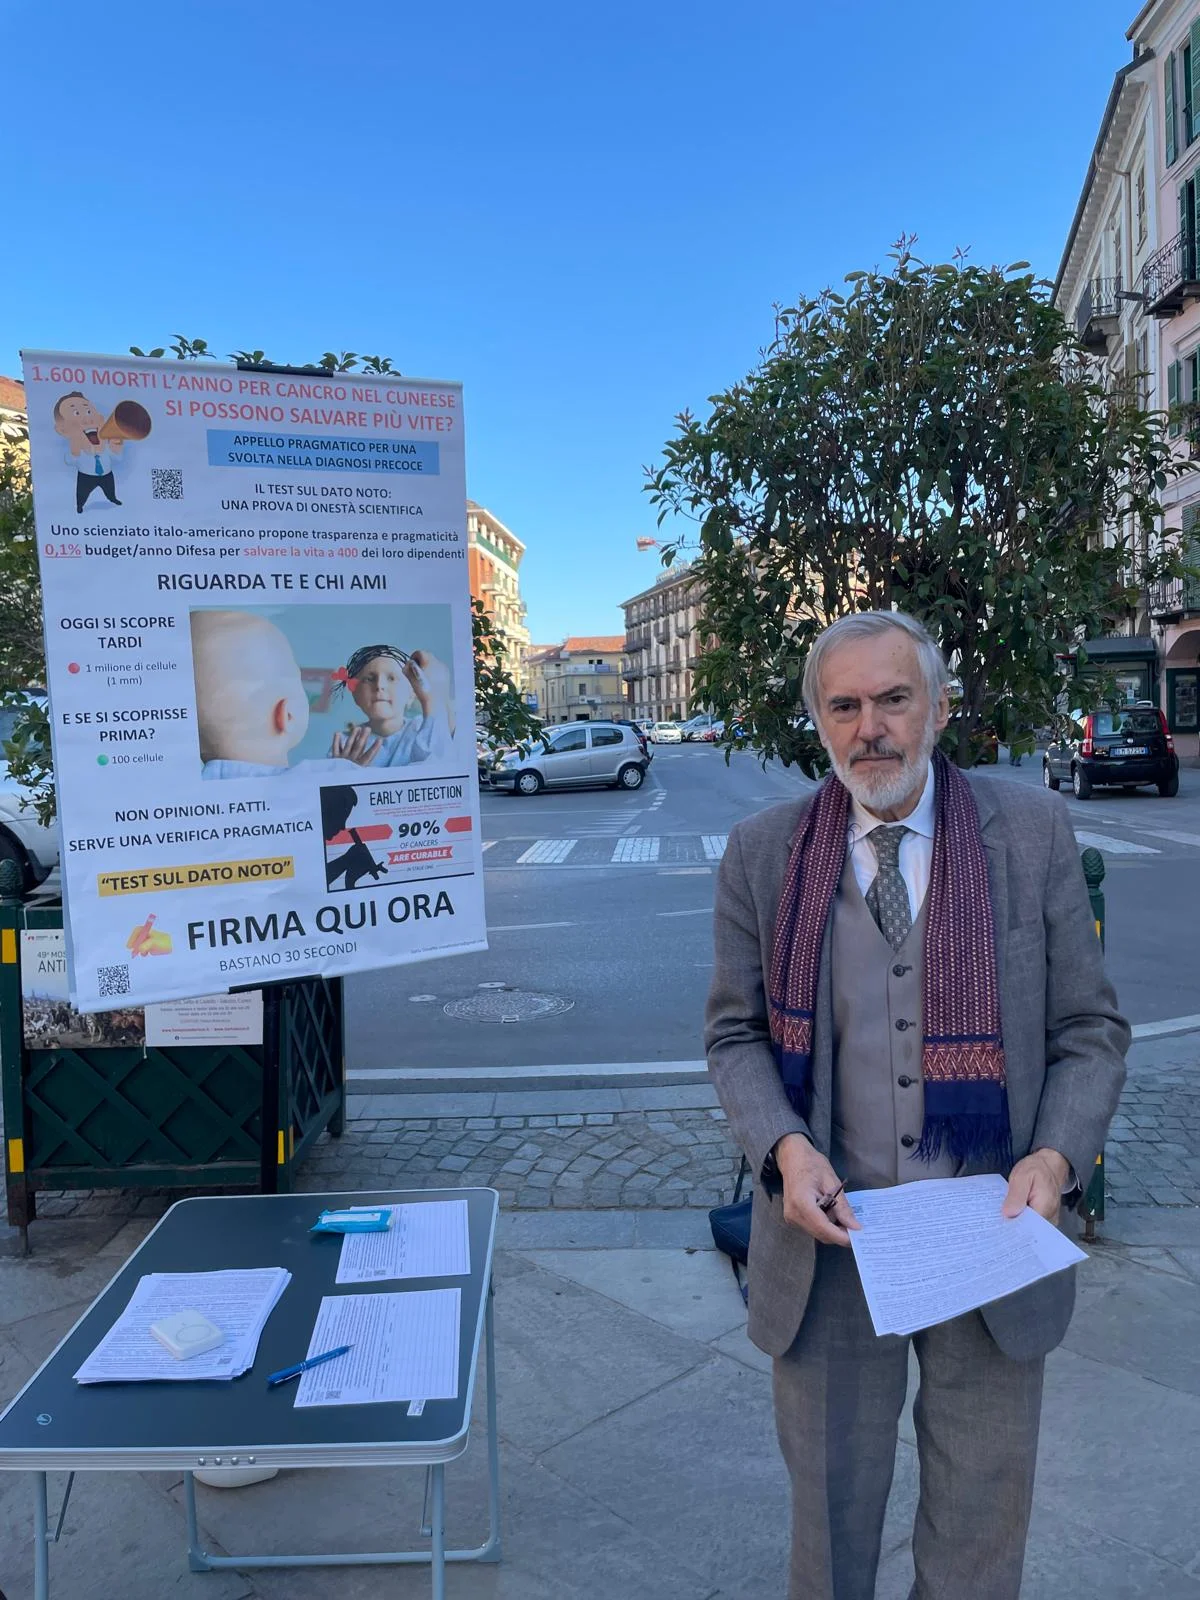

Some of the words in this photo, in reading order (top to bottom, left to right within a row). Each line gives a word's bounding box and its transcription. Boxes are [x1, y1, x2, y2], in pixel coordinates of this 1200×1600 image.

[32, 365, 85, 384] 1.600
[92, 369, 156, 388] MORTI
[239, 380, 271, 397] PER
[275, 382, 347, 401] CANCRO
[352, 388, 381, 404] NEL
[386, 390, 455, 408] CUNEESE
[166, 399, 184, 416] SI
[190, 401, 284, 422] POSSONO
[290, 407, 367, 427] SALVARE
[373, 408, 402, 429] PIÙ
[407, 414, 453, 432] VITE?
[234, 434, 284, 449] APPELLO
[288, 437, 365, 452] PRAGMATICO
[369, 441, 389, 453] PER
[392, 442, 416, 455] UNA
[228, 452, 274, 465] SVOLTA
[277, 454, 311, 467] NELLA
[316, 456, 371, 469] DIAGNOSI
[375, 458, 423, 471] PRECOCE
[255, 483, 265, 494] IL
[268, 483, 294, 495] TEST
[297, 484, 318, 496] SUL
[322, 485, 352, 497] DATO
[356, 487, 392, 499] NOTO:
[221, 500, 248, 511] UNA
[253, 500, 293, 512] PROVA
[296, 502, 308, 513] DI
[311, 499, 356, 514] ONESTÀ
[359, 503, 423, 515] SCIENTIFICA
[50, 524, 79, 536] Uno
[83, 525, 149, 537] scienziato
[154, 525, 254, 539] italo-americano
[259, 527, 308, 543] propone
[312, 530, 378, 544] trasparenza
[382, 532, 388, 541] e
[391, 529, 458, 545] pragmaticità
[44, 542, 81, 558] 0,1%
[85, 542, 172, 559] budget/anno
[176, 544, 215, 557] Difesa
[220, 547, 240, 560] per
[244, 545, 287, 557] salvare
[290, 546, 301, 557] la
[304, 547, 324, 558] vita
[328, 550, 334, 558] a
[337, 547, 358, 558] 400
[362, 548, 379, 559] dei
[382, 548, 404, 559] loro
[407, 548, 464, 562] dipendenti
[158, 573, 266, 590] RIGUARDA
[271, 573, 294, 590] TE
[300, 574, 310, 590] E
[314, 574, 344, 590] CHI
[349, 574, 386, 590] AMI
[60, 617, 99, 629] OGGI
[103, 617, 115, 629] SI
[118, 616, 175, 629] SCOPRE
[98, 636, 142, 649] TARDI
[86, 663, 91, 673] 1
[95, 662, 131, 672] milione
[134, 662, 143, 672] di
[146, 661, 176, 671] cellule
[107, 676, 116, 687] (1
[120, 675, 143, 686] mm)
[63, 712, 70, 724] E
[74, 711, 91, 724] SE
[96, 711, 109, 723] SI
[112, 708, 188, 723] SCOPRISSE
[99, 728, 155, 742] PRIMA?
[112, 755, 129, 765] 100
[133, 752, 163, 764] cellule
[370, 790, 403, 805] EARLY
[408, 785, 462, 802] DETECTION
[115, 809, 149, 822] NON
[153, 804, 225, 821] OPINIONI.
[229, 800, 270, 815] FATTI.
[69, 836, 116, 852] SERVE
[119, 834, 153, 849] UNA
[156, 826, 219, 845] VERIFICA
[223, 820, 314, 840] PRAGMATICA
[399, 819, 440, 838] 90%
[410, 840, 438, 848] CANCERS
[393, 853, 409, 862] ARE
[411, 850, 448, 860] CURABLE
[153, 870, 184, 886] SUL
[188, 865, 233, 885] DATO
[188, 910, 307, 950] FIRMA
[315, 901, 378, 934] QUI
[387, 891, 455, 924] ORA
[219, 953, 281, 972] BASTANO
[285, 950, 301, 965] 30
[304, 942, 357, 962] SECONDI
[38, 960, 66, 973] ANTI
